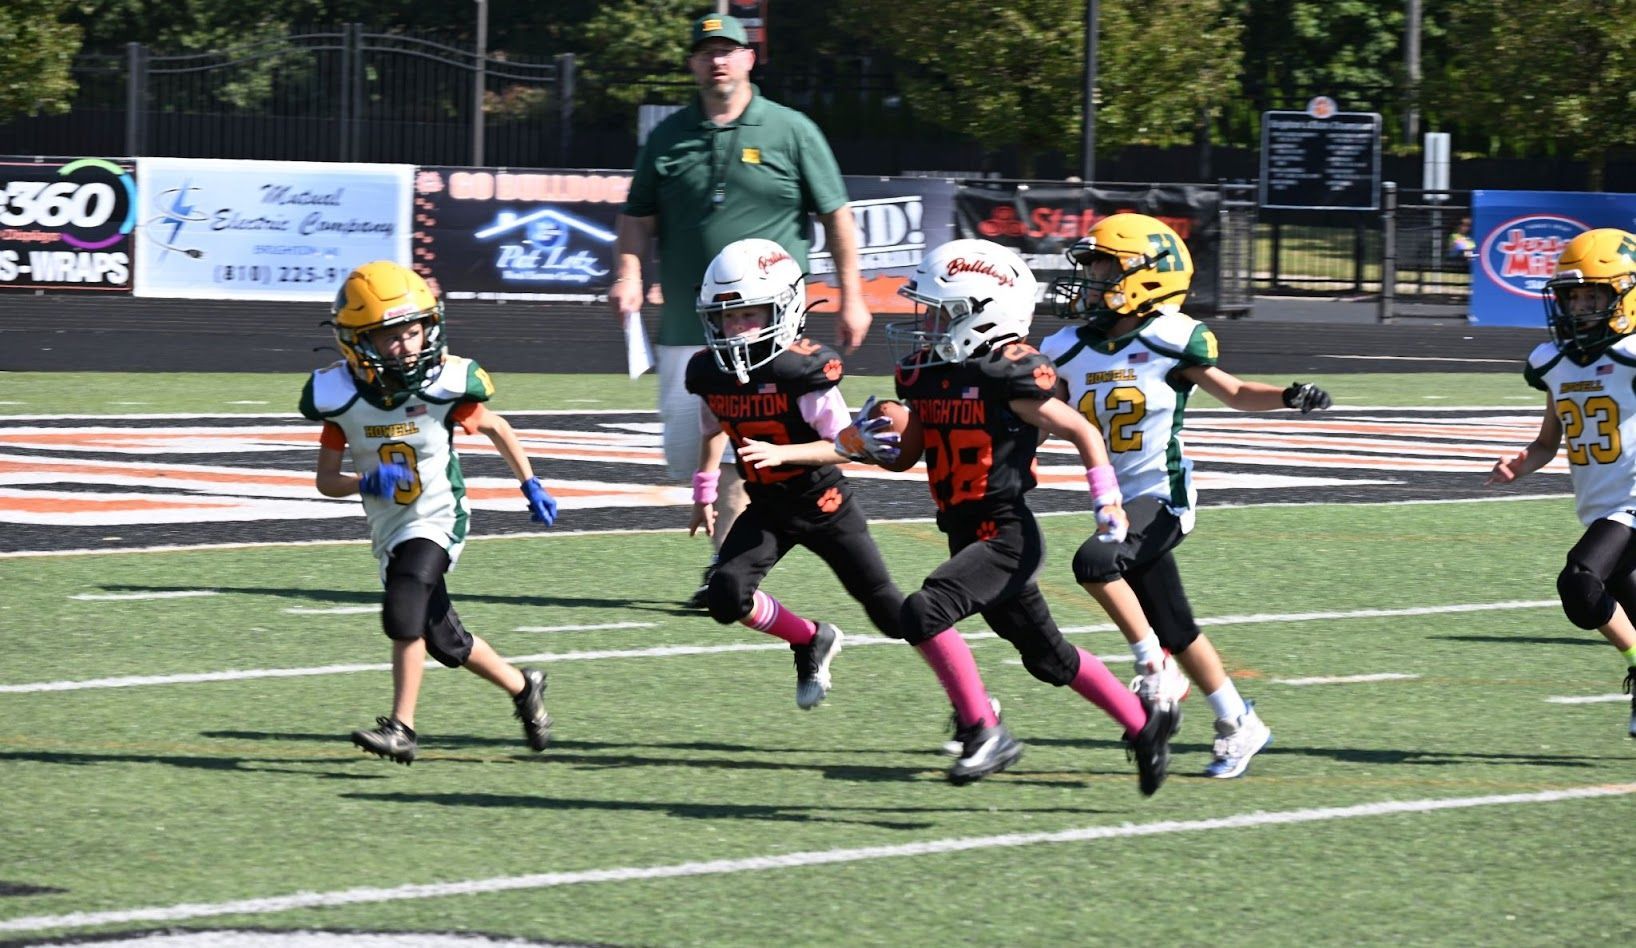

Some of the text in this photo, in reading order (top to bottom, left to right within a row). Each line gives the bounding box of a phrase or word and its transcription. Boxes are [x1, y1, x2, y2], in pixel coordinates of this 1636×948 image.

[0, 181, 116, 228] 360
[258, 184, 345, 206] Mutual
[209, 209, 396, 239] Electric Company
[213, 265, 272, 284] (810)
[946, 256, 1016, 289] Bulldogs
[1085, 367, 1137, 386] HOWELL
[363, 422, 420, 438] HOWELL
[1077, 386, 1147, 454] 12
[1556, 396, 1623, 466] 23
